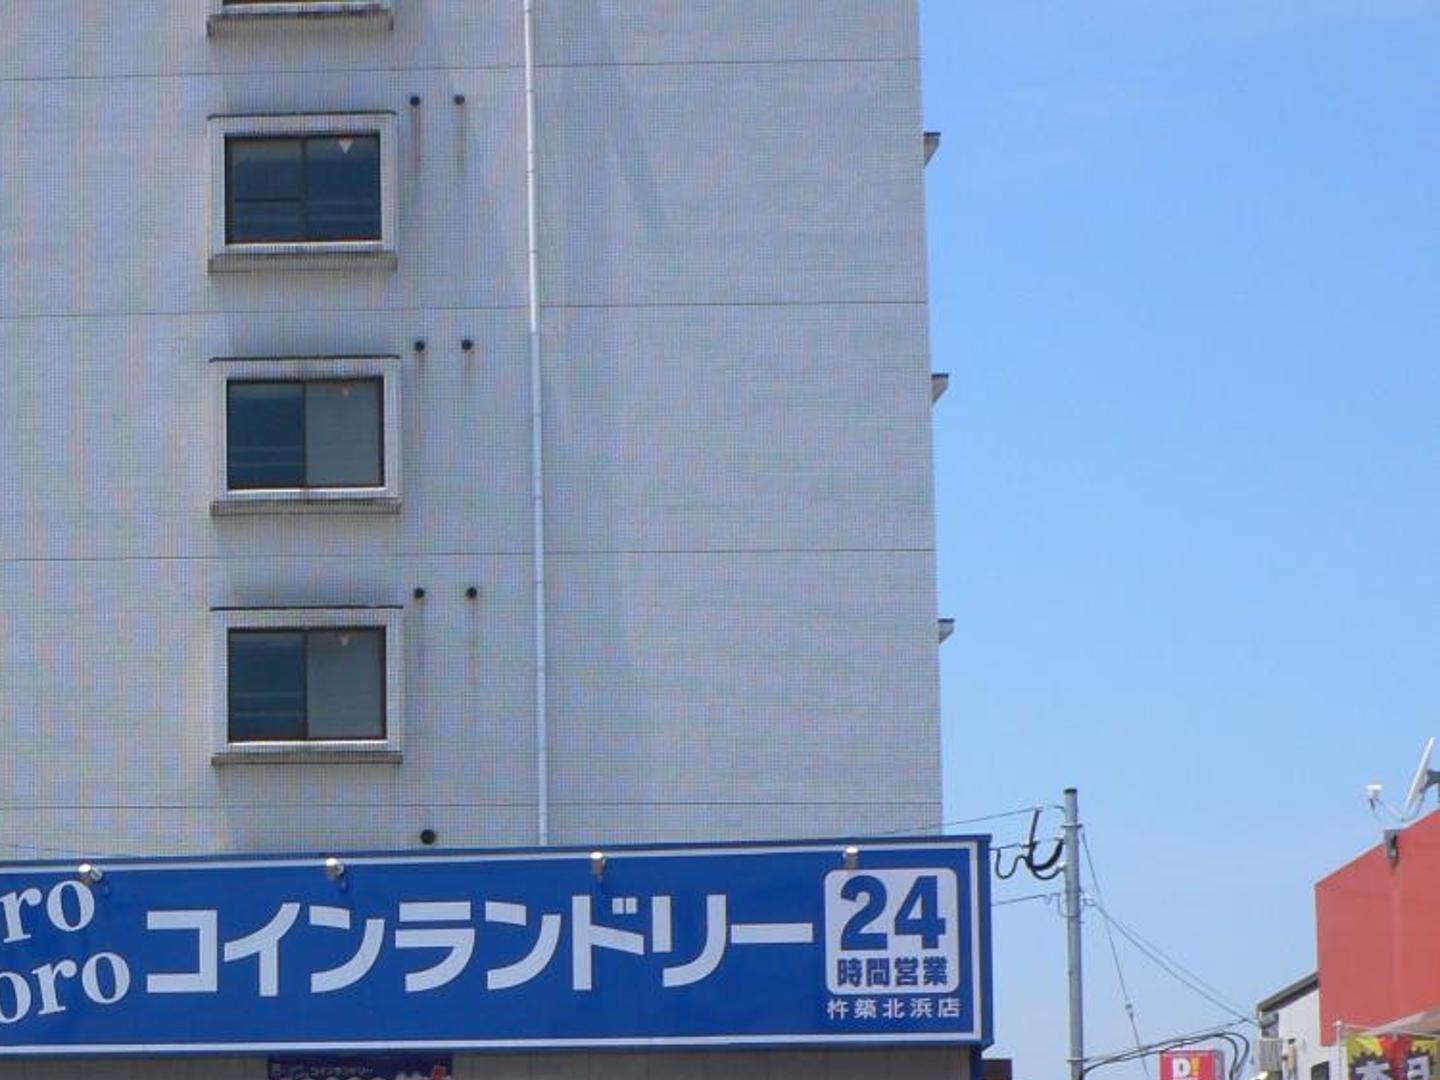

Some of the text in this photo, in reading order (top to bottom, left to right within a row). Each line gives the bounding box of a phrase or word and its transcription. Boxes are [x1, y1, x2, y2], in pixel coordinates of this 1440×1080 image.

[840, 875, 947, 951] 24
[146, 894, 813, 996] コインランドリー
[836, 956, 948, 987] 時間営業
[827, 998, 961, 1020] 杵築北浜店
